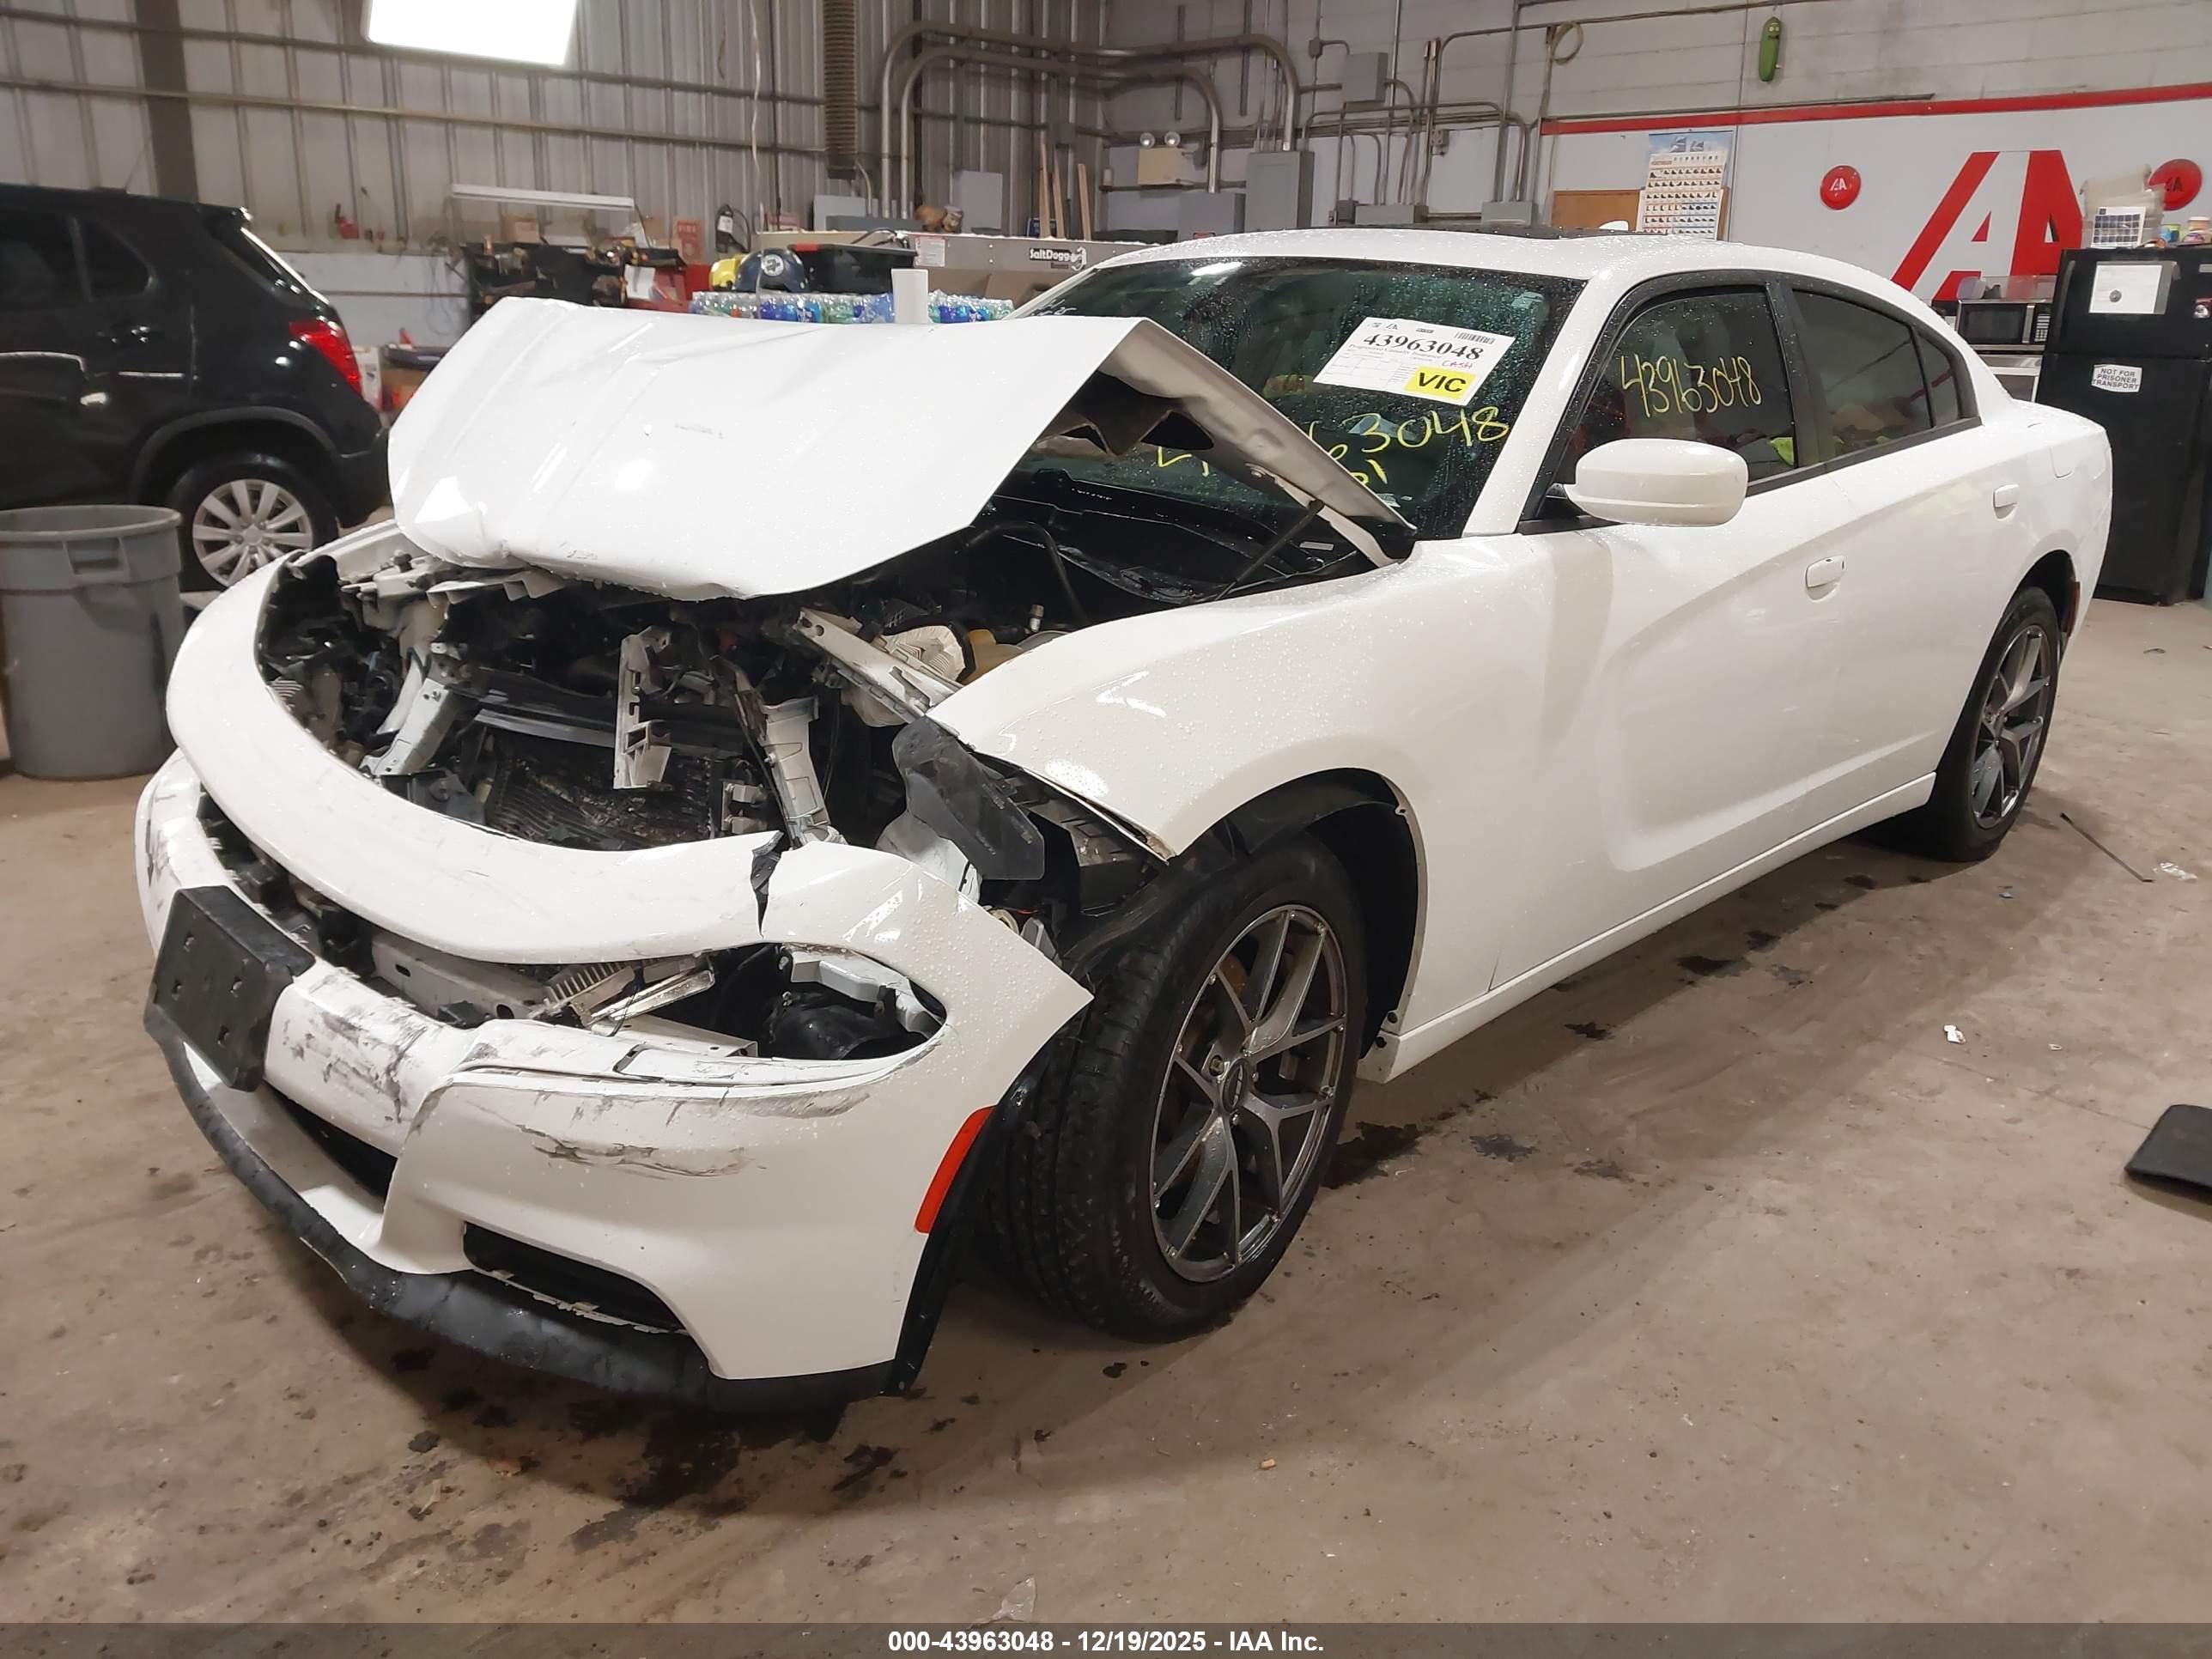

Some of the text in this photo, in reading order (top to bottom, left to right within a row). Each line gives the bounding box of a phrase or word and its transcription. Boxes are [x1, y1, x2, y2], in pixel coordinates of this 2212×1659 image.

[1030, 248, 1071, 261] SaltDogg
[1364, 333, 1484, 361] 43963048
[1442, 359, 1474, 369] CASH
[1418, 372, 1467, 393] VIC
[2092, 380, 2140, 390] TRANSPORT
[2097, 374, 2137, 383] PRISONER
[1621, 354, 1762, 418] 43963048
